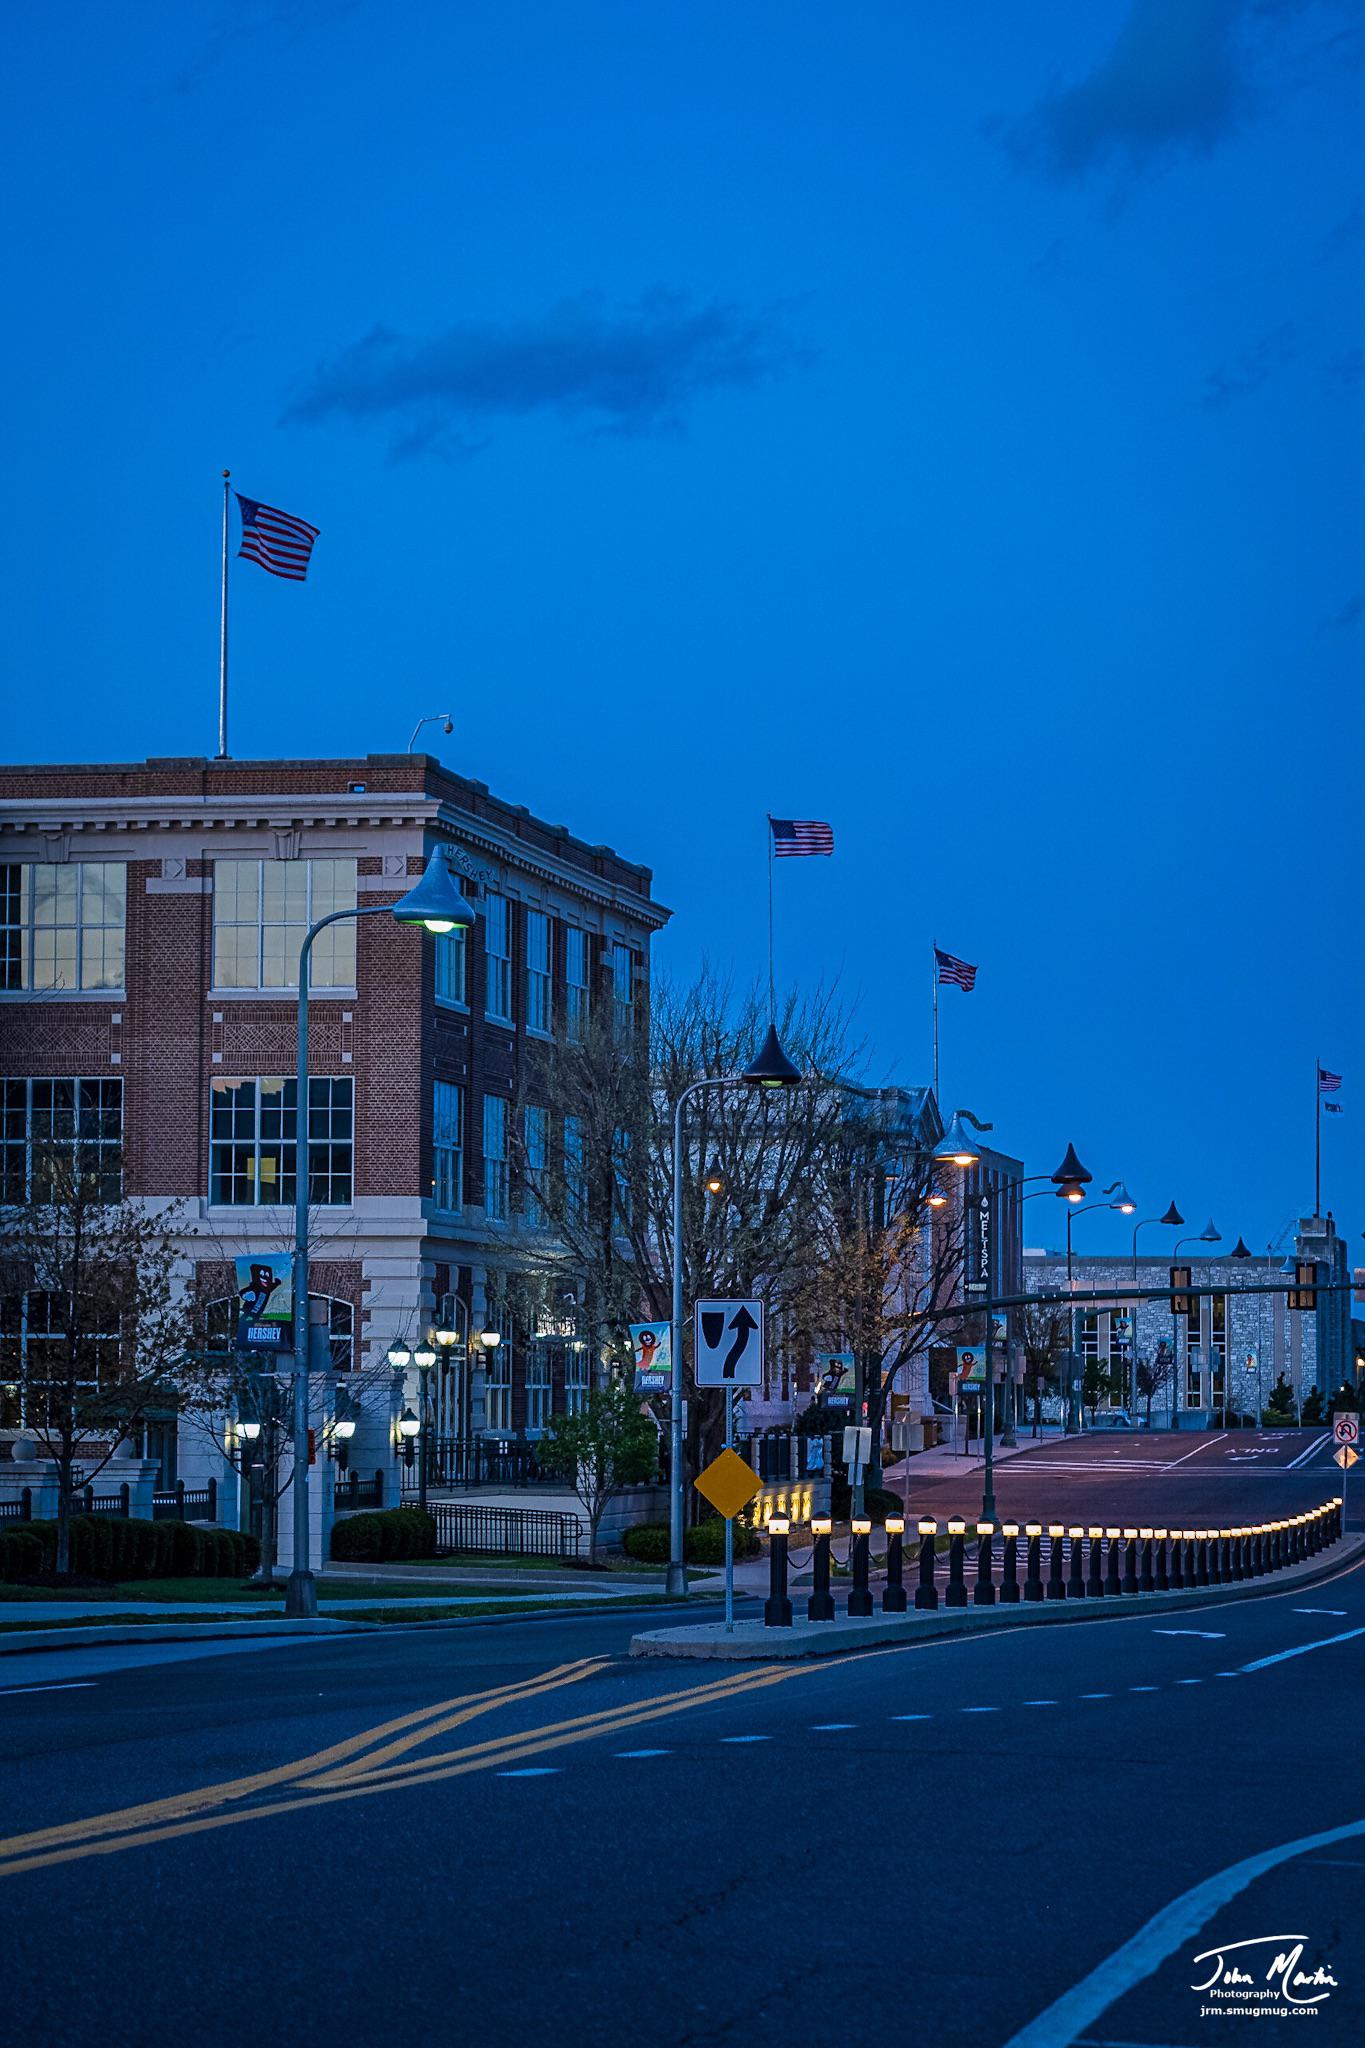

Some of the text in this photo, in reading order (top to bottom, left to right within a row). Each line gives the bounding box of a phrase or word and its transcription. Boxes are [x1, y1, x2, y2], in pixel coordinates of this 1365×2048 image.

[447, 845, 493, 881] HERSHEY
[980, 1211, 989, 1278] MELTSPA
[248, 1327, 281, 1340] HERSHEY
[642, 1375, 665, 1386] HERSHEY
